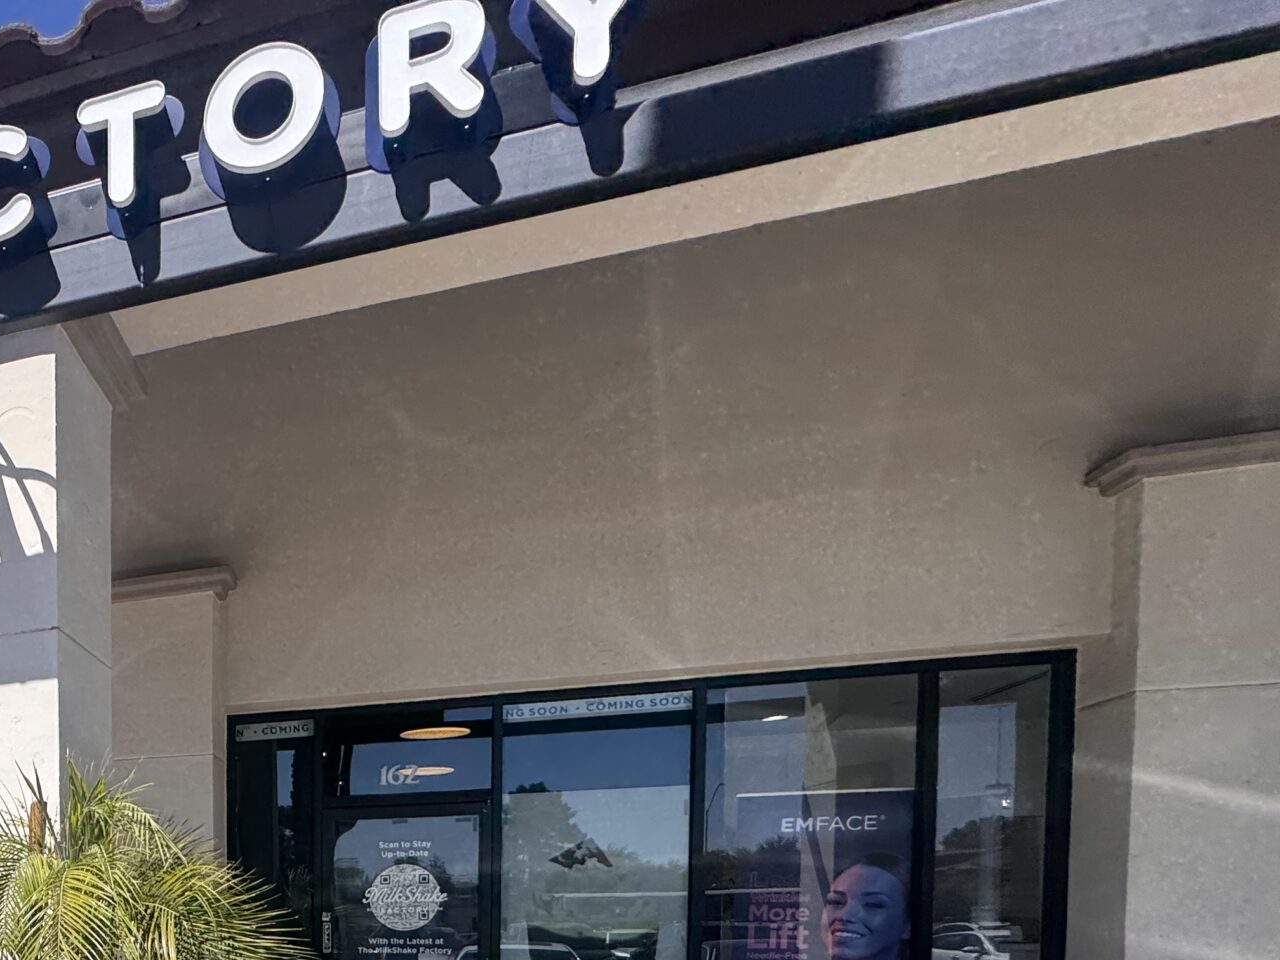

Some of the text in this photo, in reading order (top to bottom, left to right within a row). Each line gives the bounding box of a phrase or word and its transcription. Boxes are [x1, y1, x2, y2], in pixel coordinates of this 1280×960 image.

[528, 705, 568, 717] SOON
[586, 699, 645, 712] COMING
[649, 696, 692, 708] SOON
[261, 724, 309, 735] COMING
[379, 764, 420, 785] 162
[378, 840, 432, 849] Scan to Stay
[381, 849, 429, 858] Up-to-Date
[362, 885, 448, 905] MilkShake
[748, 904, 810, 921] More
[368, 937, 444, 945] With the Latest at
[747, 922, 810, 950] Lift
[358, 946, 452, 955] The MilkShake Factory
[746, 951, 809, 960] Needle-Free
